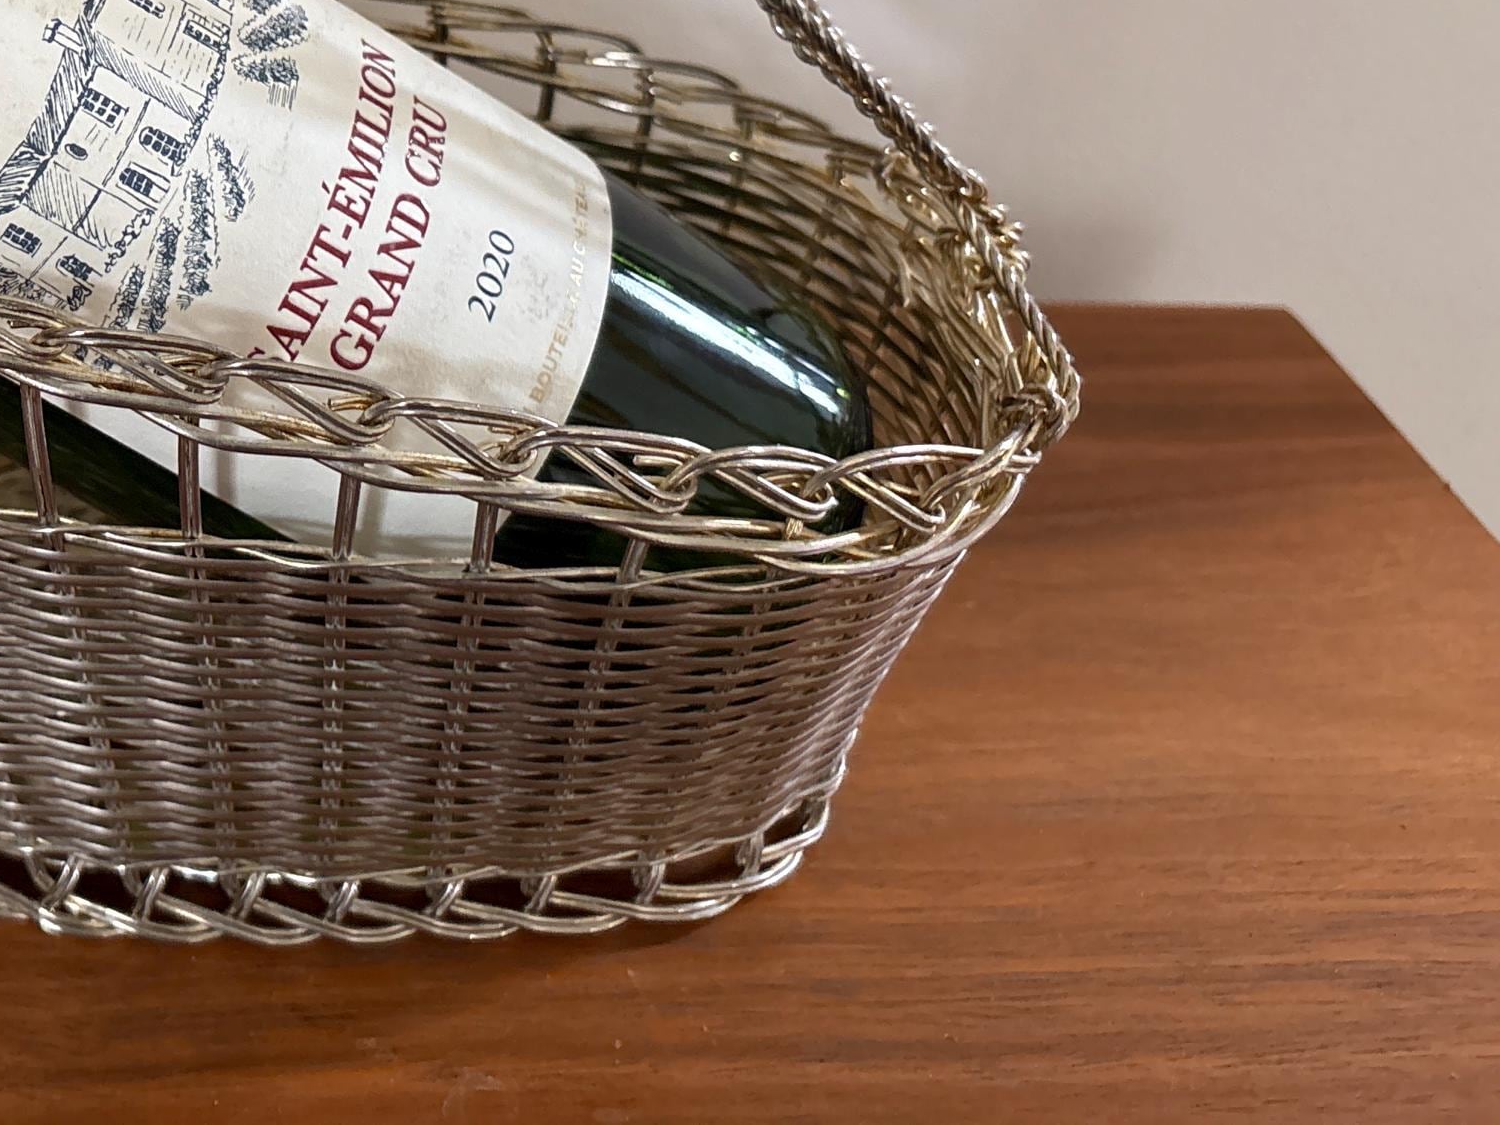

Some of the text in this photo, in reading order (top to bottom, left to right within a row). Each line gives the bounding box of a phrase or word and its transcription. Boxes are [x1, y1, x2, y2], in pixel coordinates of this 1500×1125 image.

[247, 38, 396, 362] AINT-ÉMILION
[330, 94, 448, 371] GRAND CRU
[467, 230, 515, 323] 2020
